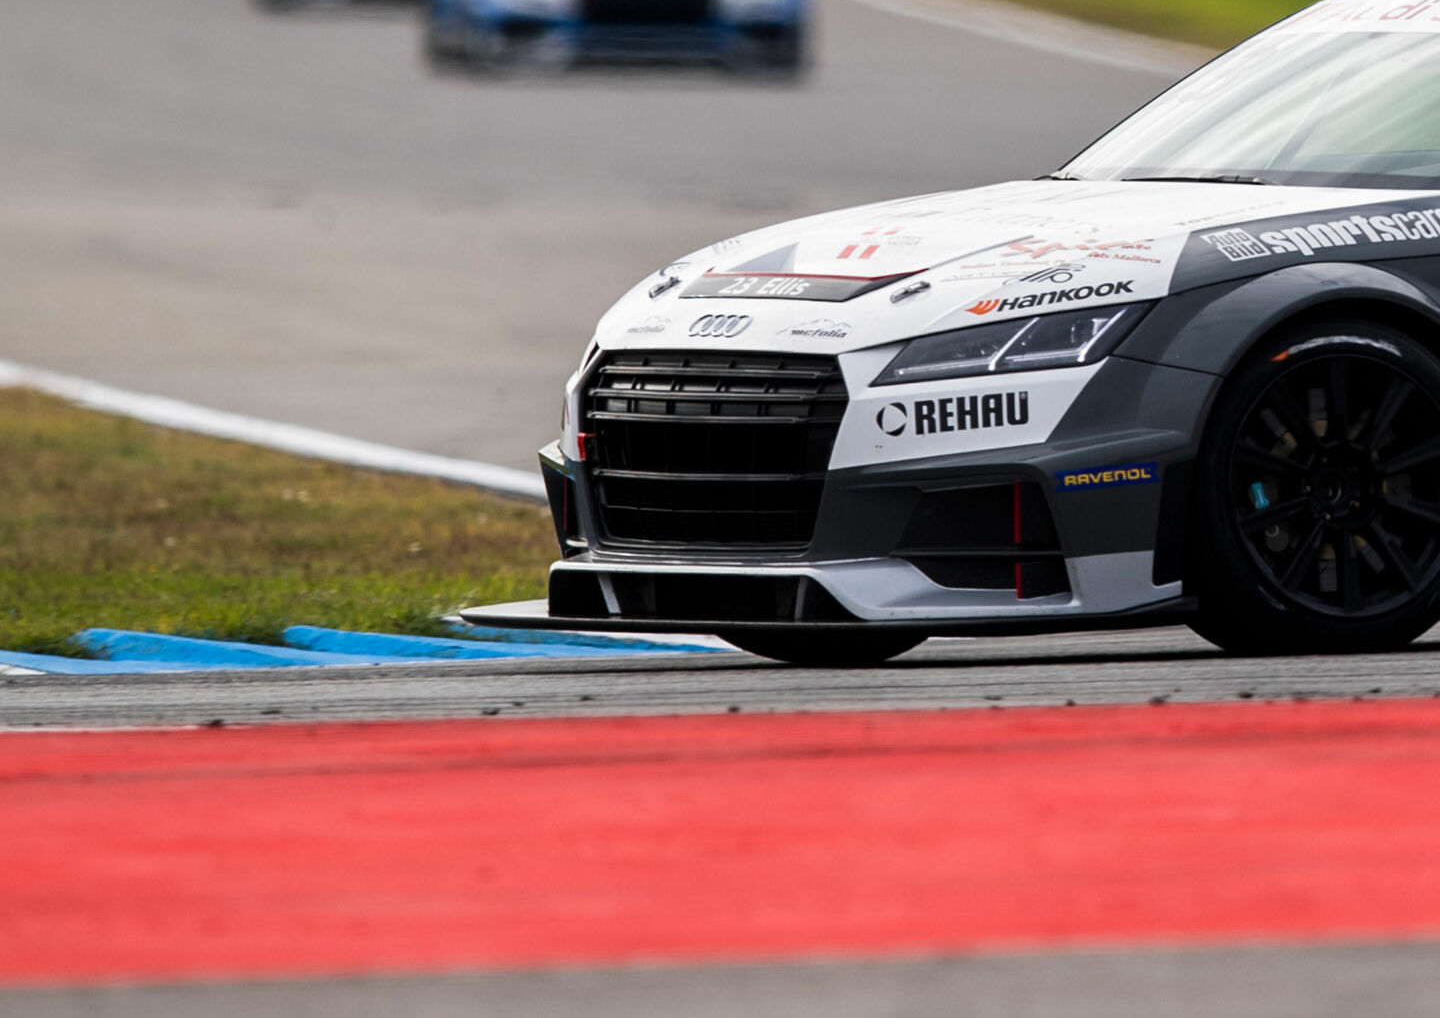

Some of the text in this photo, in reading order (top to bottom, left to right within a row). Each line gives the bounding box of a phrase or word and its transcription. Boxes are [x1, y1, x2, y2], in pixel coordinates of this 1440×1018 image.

[1222, 242, 1266, 260] Bild
[718, 278, 811, 296] 23 Ellis
[914, 391, 1029, 435] REHAU
[1064, 468, 1151, 486] RAVENOL
